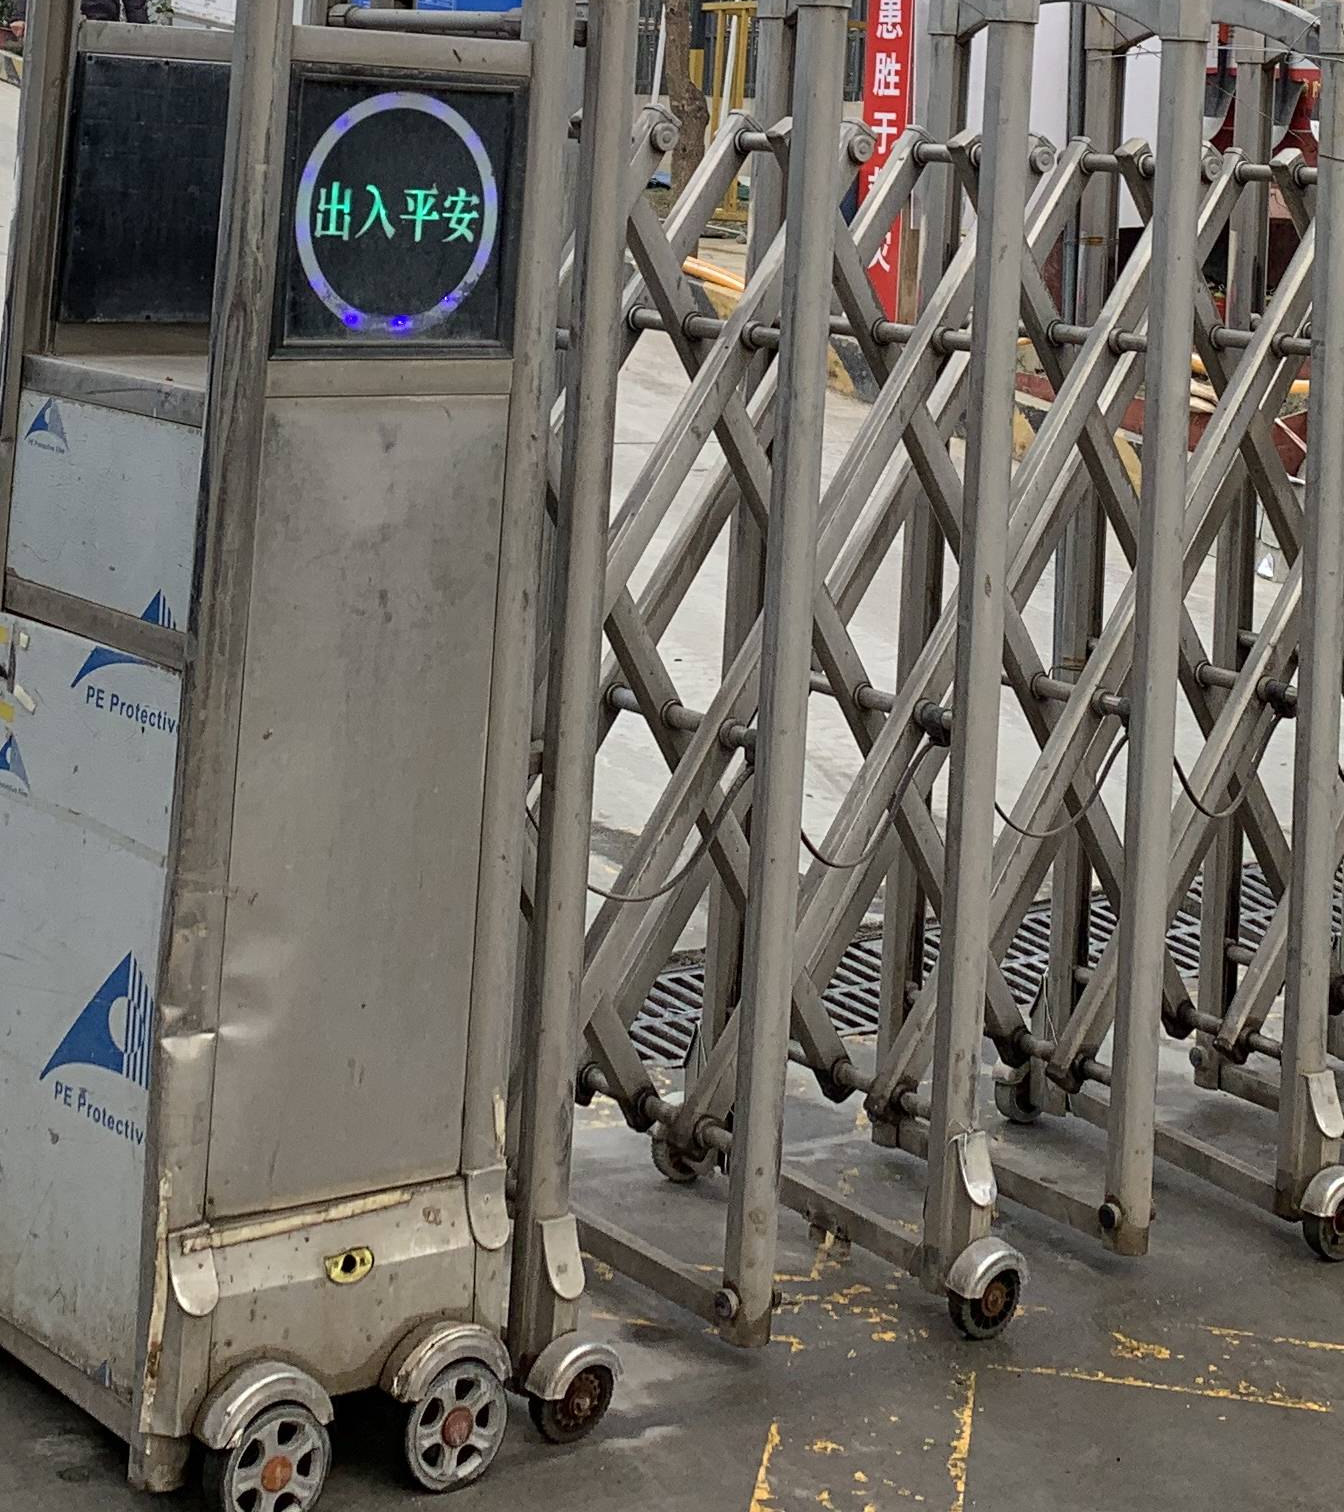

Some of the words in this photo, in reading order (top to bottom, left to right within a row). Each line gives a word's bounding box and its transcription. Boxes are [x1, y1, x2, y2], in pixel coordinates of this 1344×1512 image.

[314, 181, 480, 242] 出入平安
[86, 685, 105, 709] PE
[54, 1081, 72, 1108] PE
